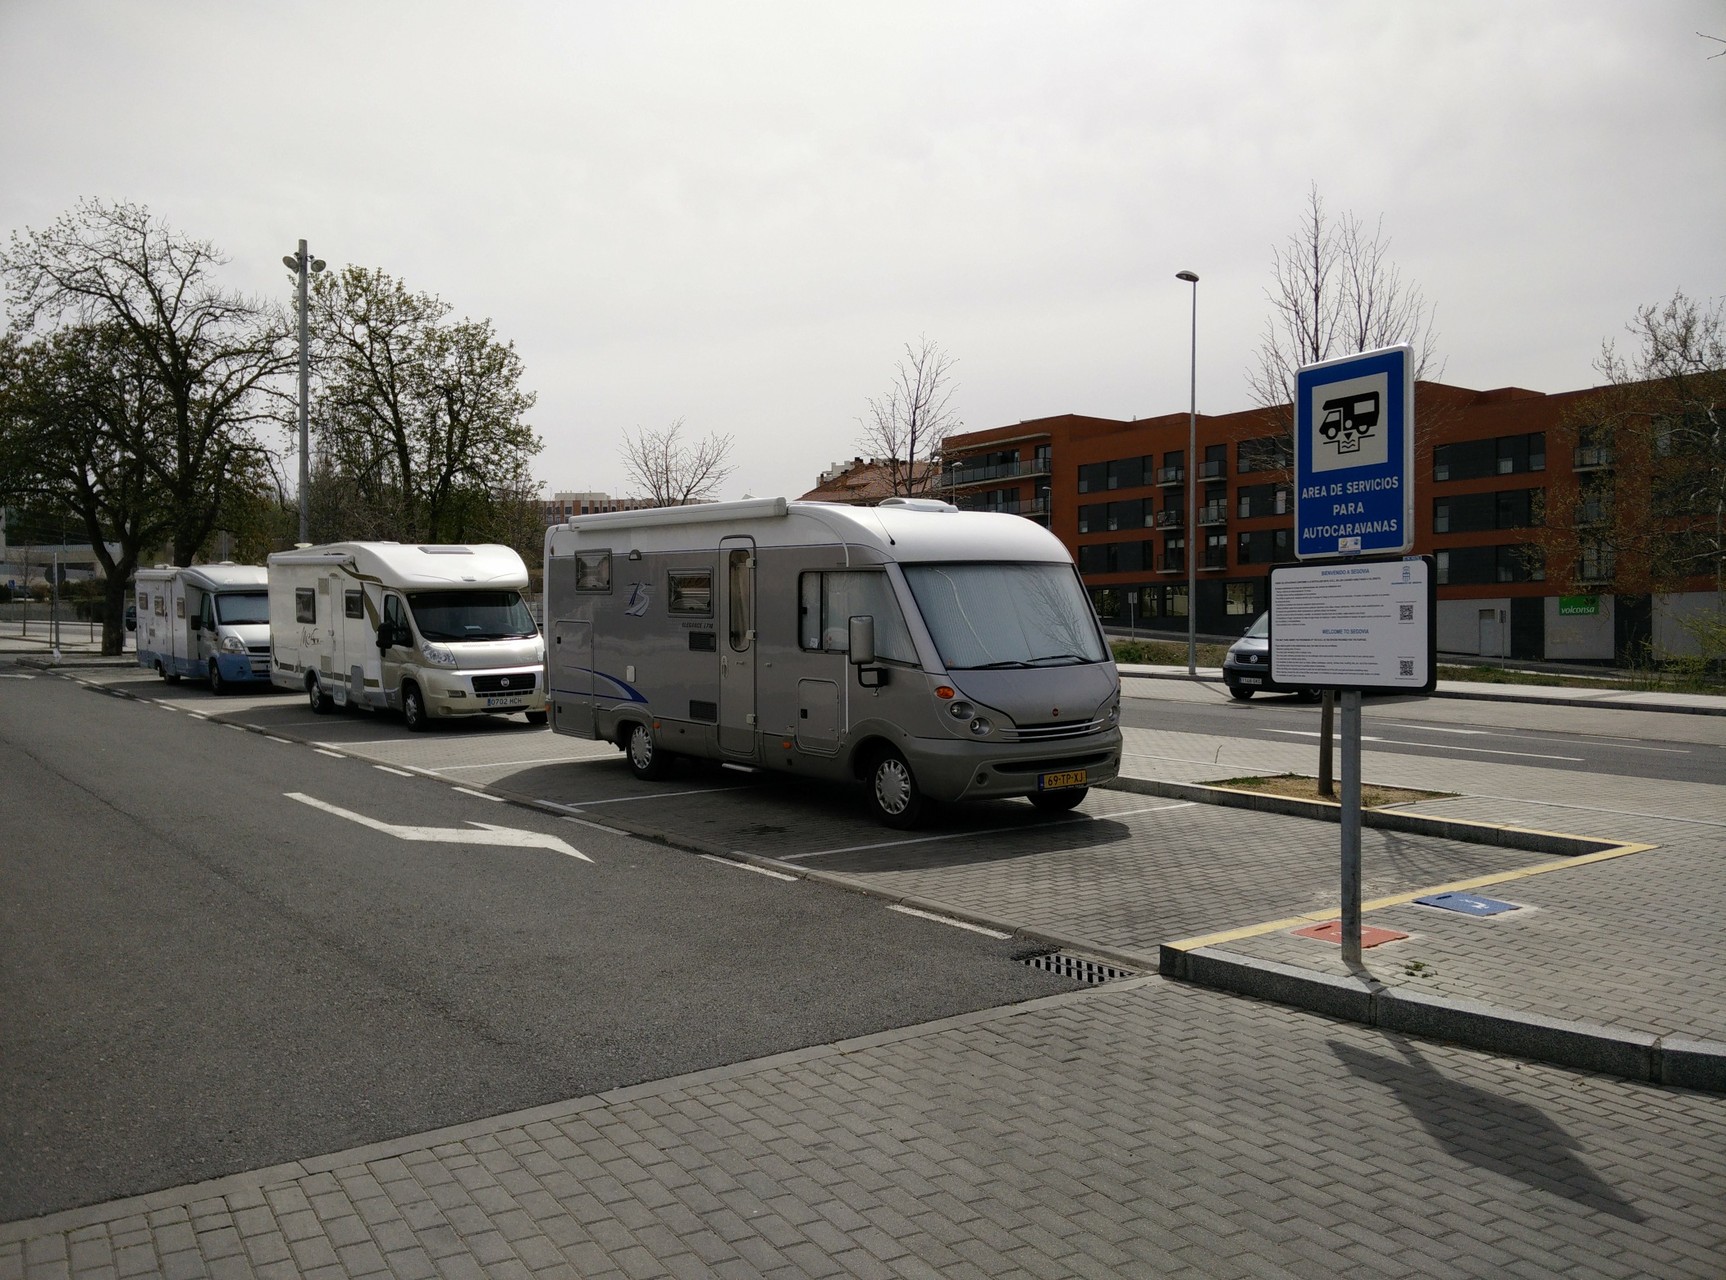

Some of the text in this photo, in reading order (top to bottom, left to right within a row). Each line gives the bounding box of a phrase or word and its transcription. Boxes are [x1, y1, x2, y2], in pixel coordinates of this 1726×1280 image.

[1301, 476, 1399, 499] AREA DE SERVICIOS
[1333, 502, 1364, 516] PARA
[1303, 519, 1398, 539] AUTOCARAVANAS
[1561, 605, 1595, 614] volconsa
[1047, 772, 1083, 786] 69-TP-XJ
